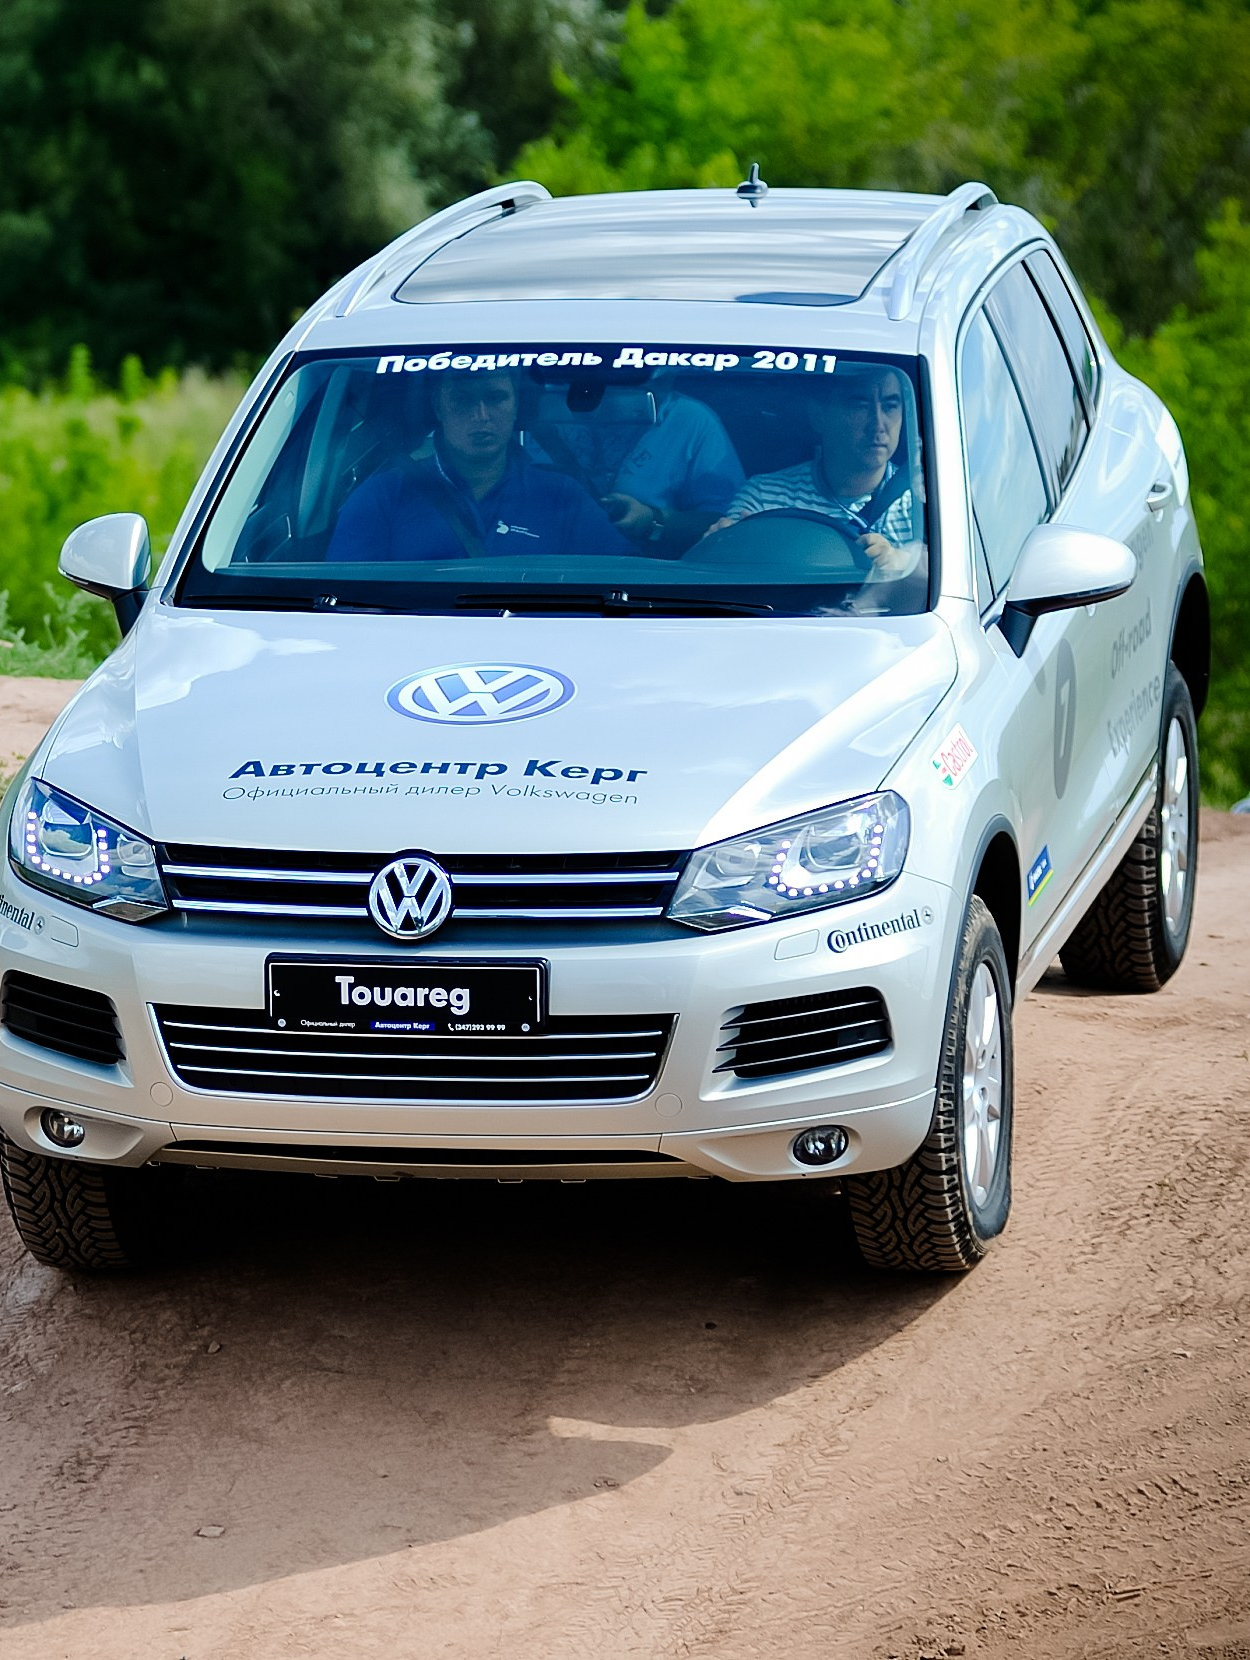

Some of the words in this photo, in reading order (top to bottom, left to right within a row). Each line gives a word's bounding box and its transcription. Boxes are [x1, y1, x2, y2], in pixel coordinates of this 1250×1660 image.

[375, 350, 602, 374] Победитель
[613, 347, 739, 372] Дакар
[751, 350, 837, 373] 2011
[228, 760, 508, 780] Автоцентр
[523, 759, 648, 785] Керг
[222, 783, 399, 801] Официальный
[404, 785, 481, 798] дилер
[490, 784, 638, 804] Volkswagen
[827, 909, 921, 953] Continental
[335, 975, 470, 1015] Touareg
